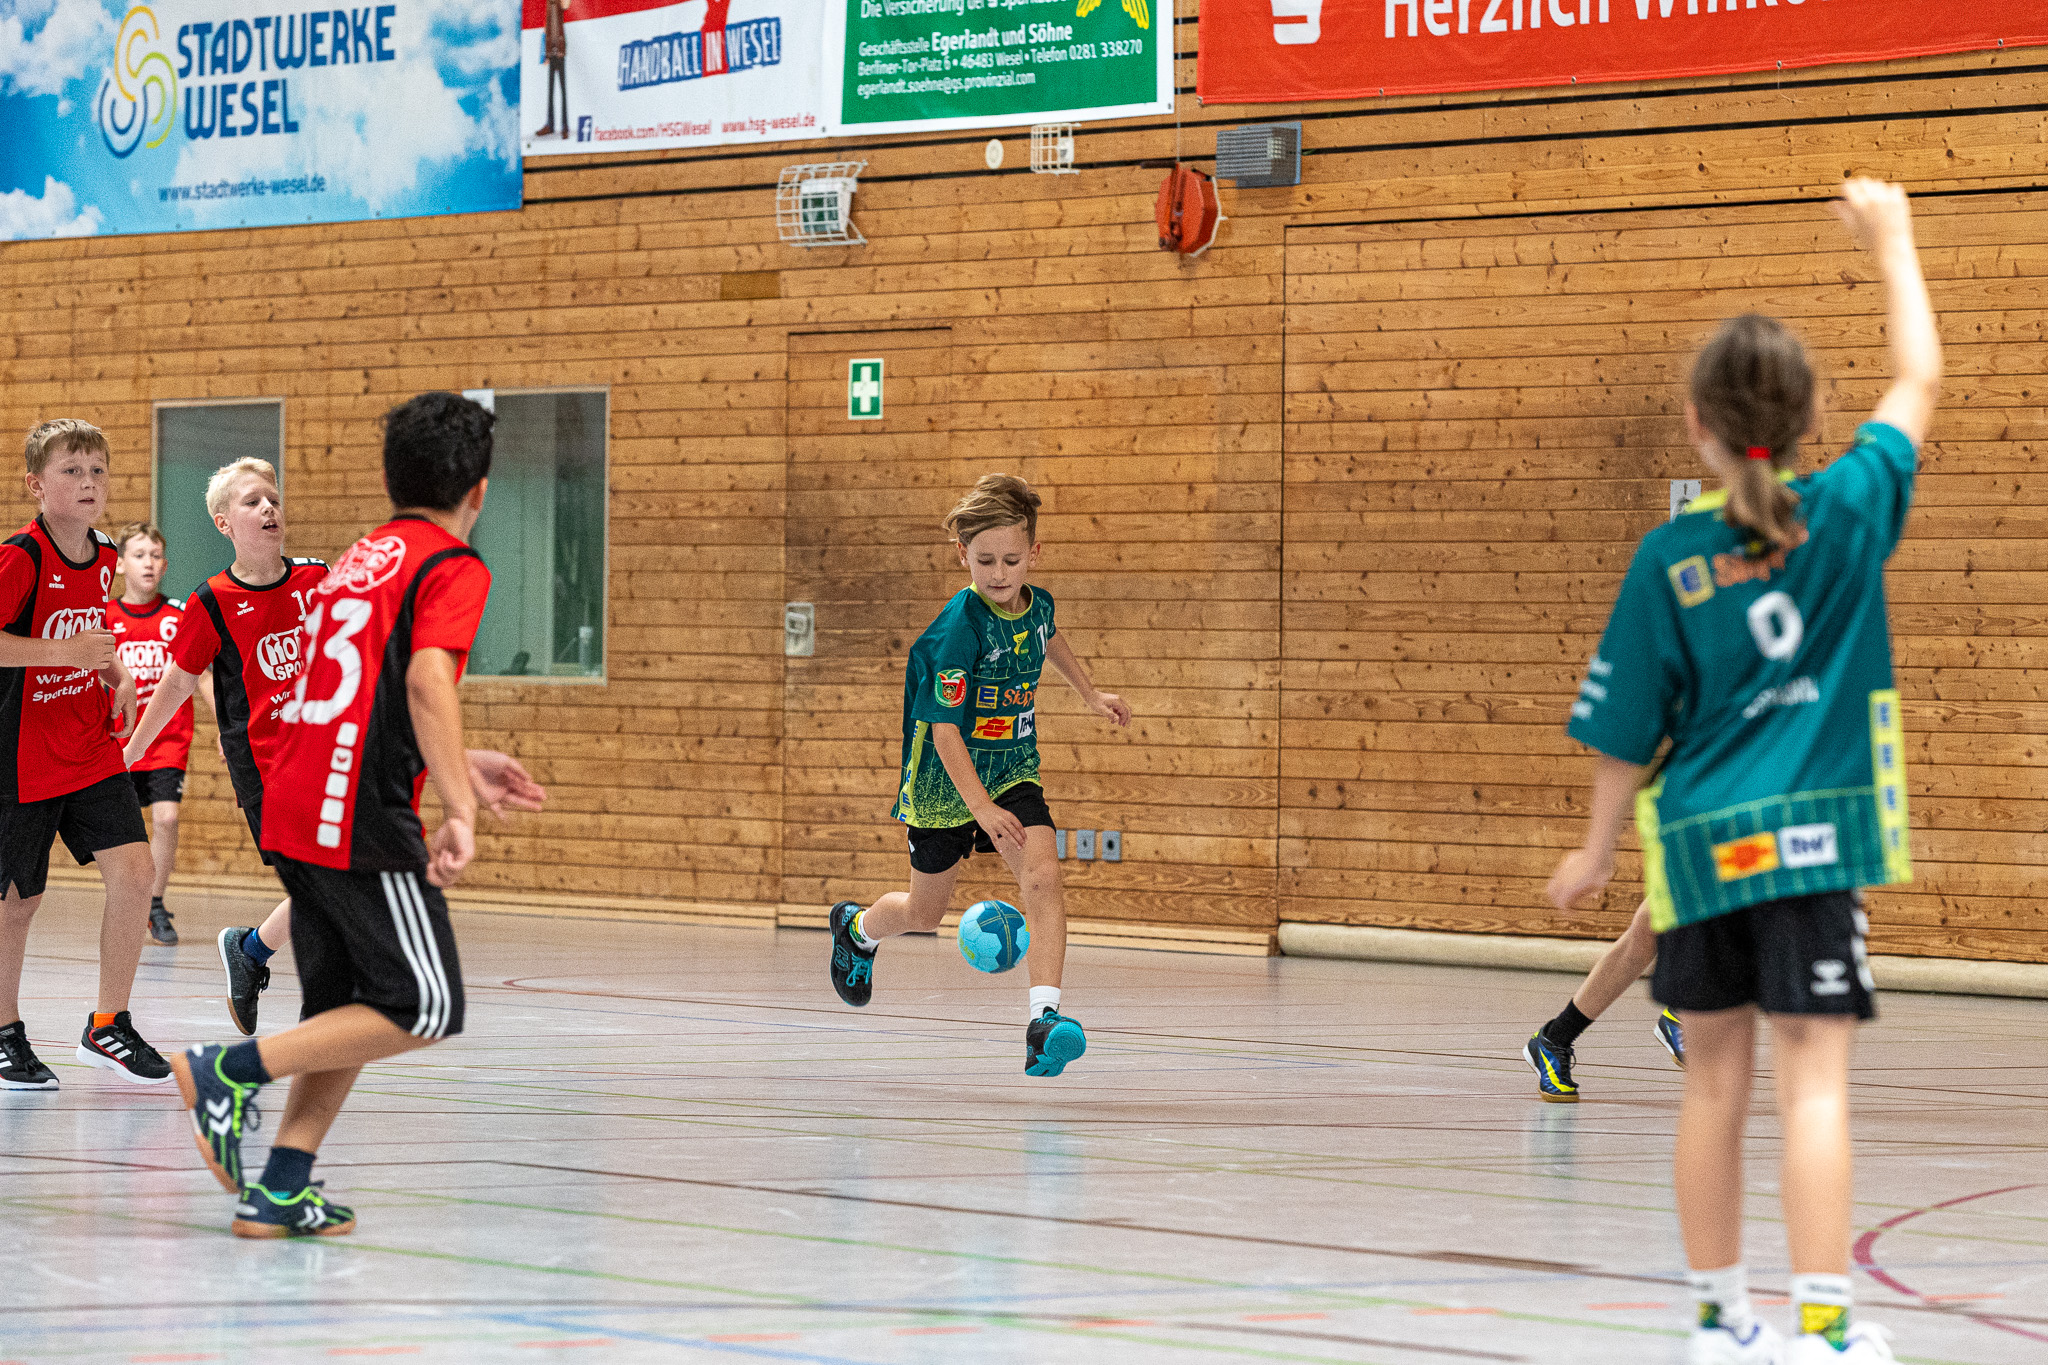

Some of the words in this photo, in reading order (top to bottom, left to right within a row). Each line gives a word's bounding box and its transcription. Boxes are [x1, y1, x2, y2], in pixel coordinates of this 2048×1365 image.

[860, 0, 882, 18] Die
[883, 0, 965, 16] Versicherung
[177, 5, 396, 79] STADTWERKE
[618, 35, 701, 86] HANDBALL
[706, 29, 723, 72] IN
[725, 21, 780, 68] WESEL
[931, 27, 999, 56] Egerlandt
[1001, 23, 1026, 47] und
[1028, 21, 1073, 44] Söhne
[943, 55, 952, 71] 6
[960, 53, 994, 69] 46483
[994, 49, 1024, 67] Wesel
[1030, 46, 1068, 63] Telefon
[1068, 43, 1098, 60] 0281
[1100, 39, 1143, 58] 338270
[184, 78, 299, 140] WESEL
[721, 112, 815, 135] www.hsg-wesel.de
[157, 171, 327, 202] www.stadtwerke-wesel.de
[159, 615, 178, 642] 6
[1747, 590, 1804, 663] 0
[36, 672, 62, 685] Wir
[64, 667, 93, 682] zieh
[275, 659, 304, 681] SPO
[281, 597, 373, 725] 13
[32, 685, 83, 703] Sportler
[270, 690, 292, 704] Wir
